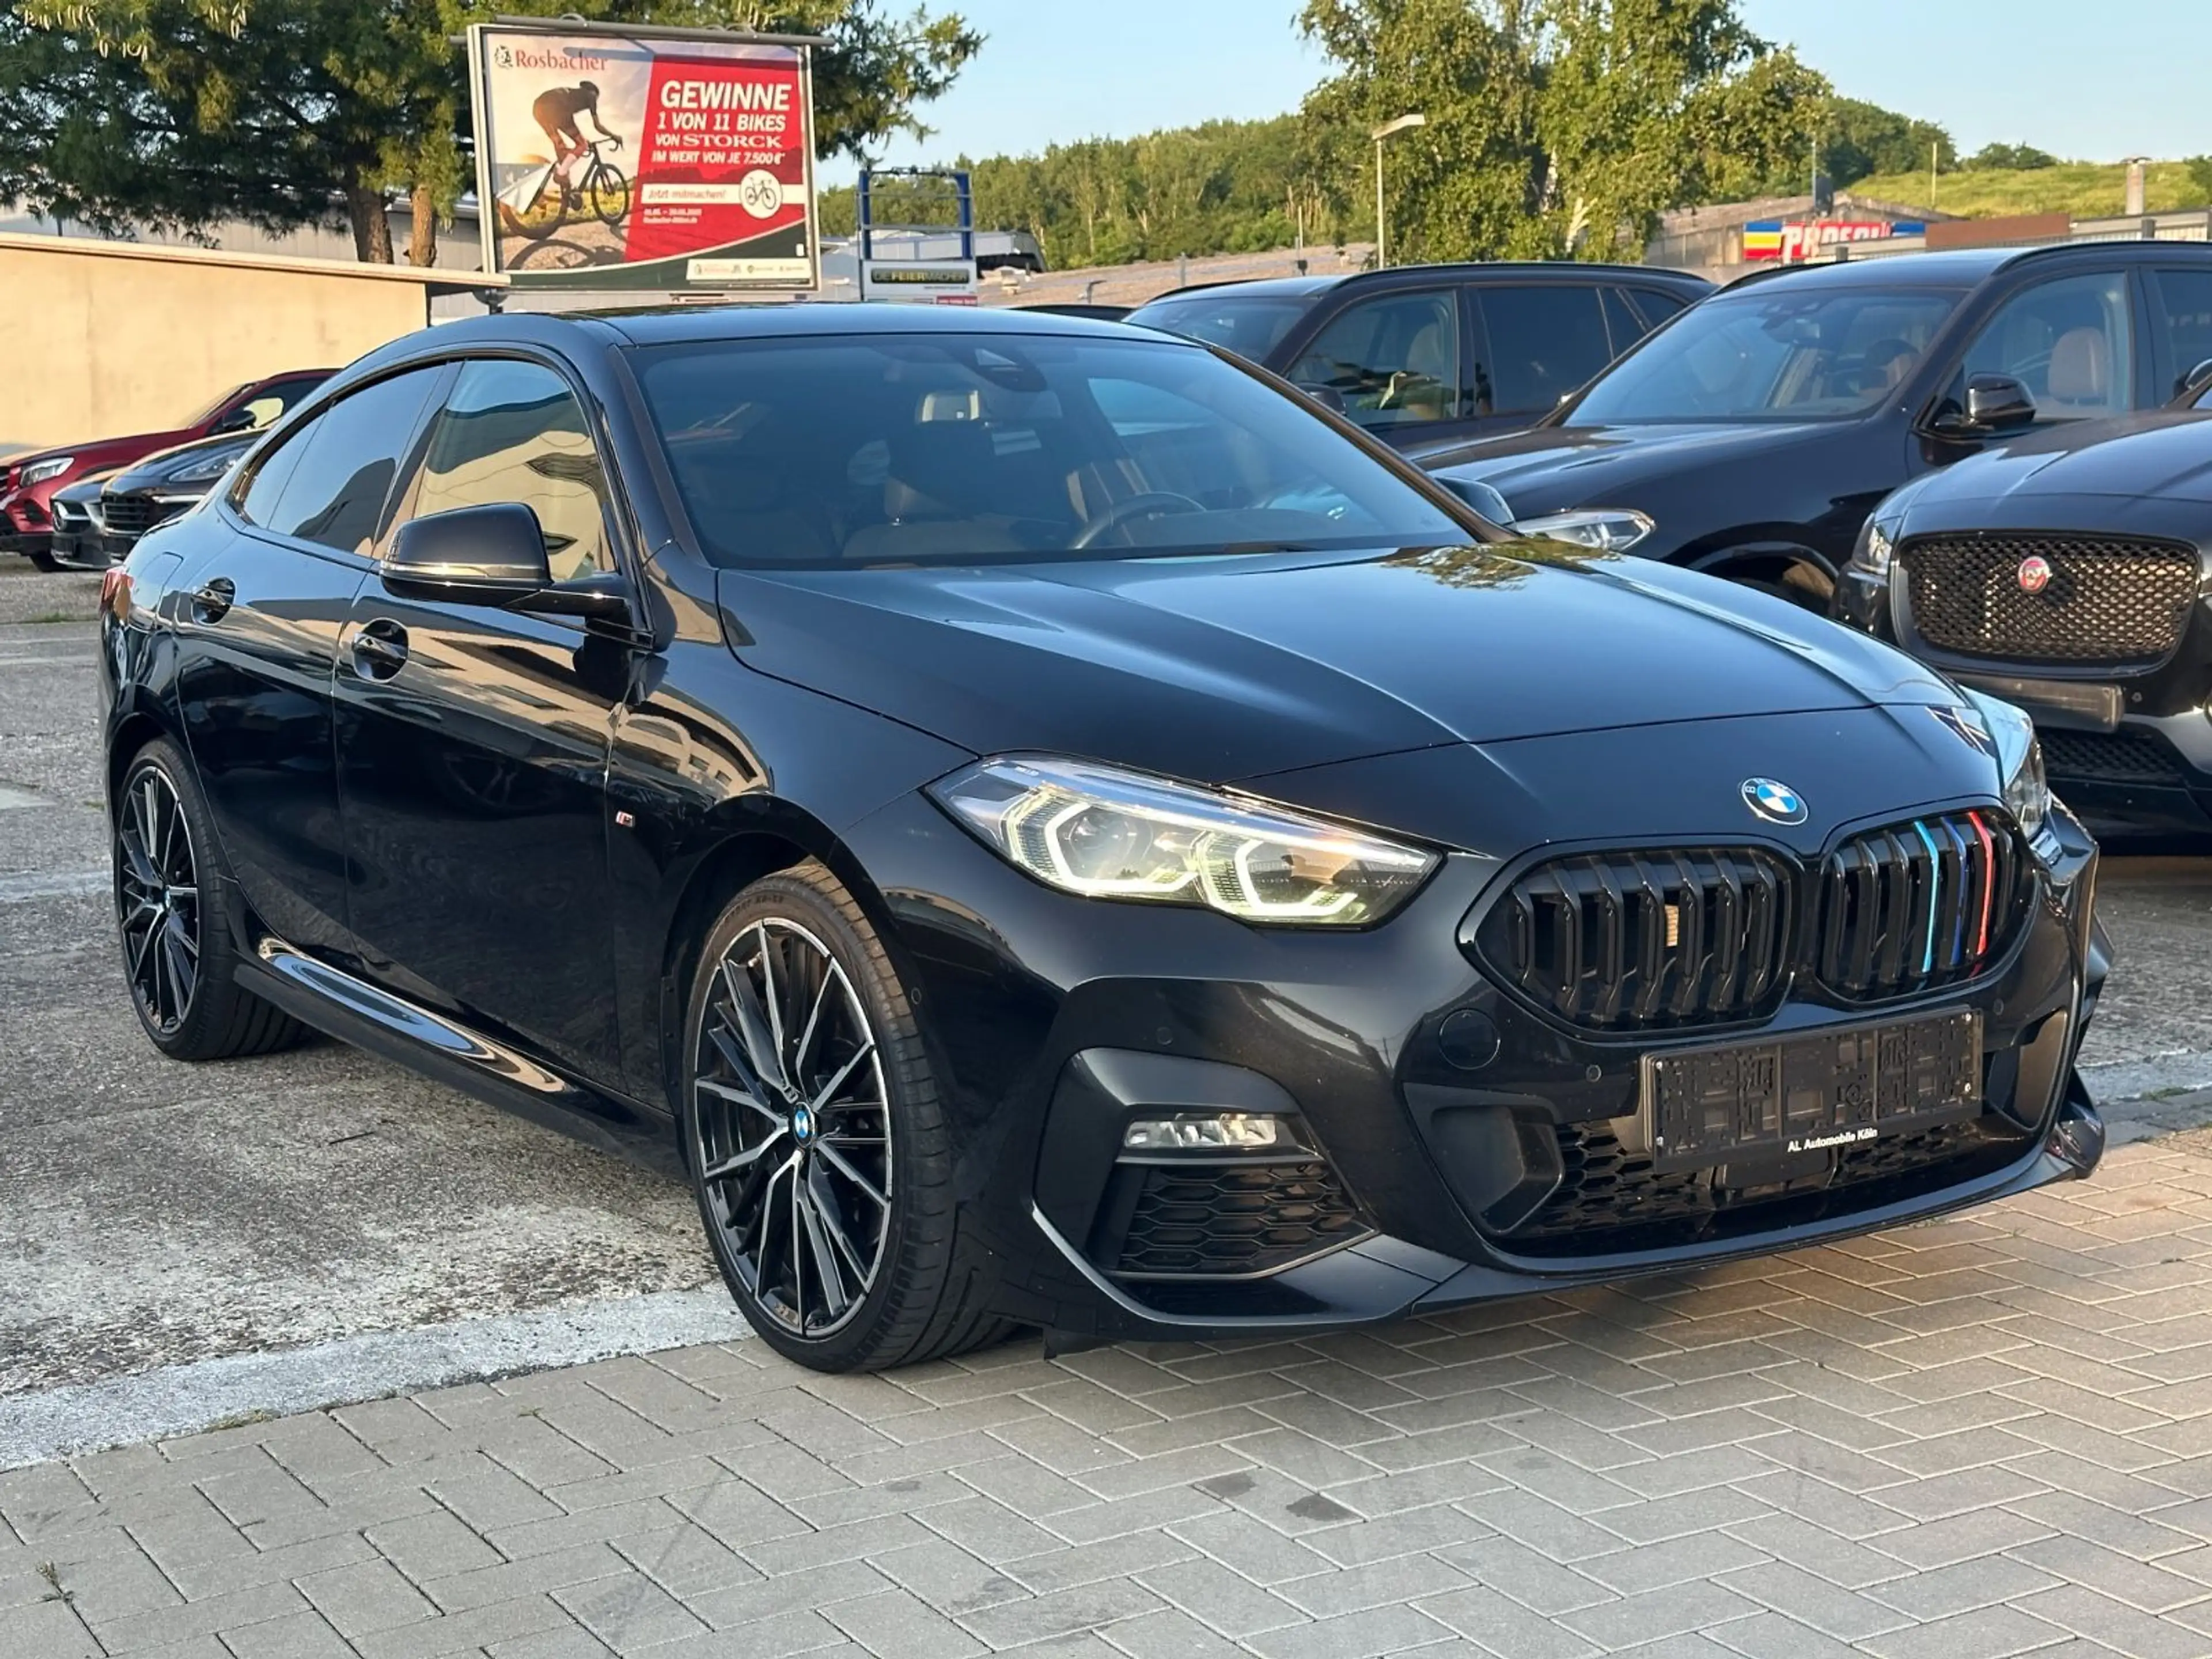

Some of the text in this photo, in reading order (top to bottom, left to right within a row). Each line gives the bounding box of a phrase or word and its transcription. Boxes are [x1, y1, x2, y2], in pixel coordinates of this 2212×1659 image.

[516, 48, 608, 70] Rosbacher
[661, 80, 792, 111] GEWINNE
[657, 111, 786, 132] 1 VON 11 BIKES
[655, 133, 783, 148] VON STORCK
[652, 150, 666, 162] IM
[669, 150, 700, 164] WERT
[702, 150, 726, 164] VON
[728, 151, 741, 164] JE
[1787, 1127, 1878, 1153] AL Automobile Köln
